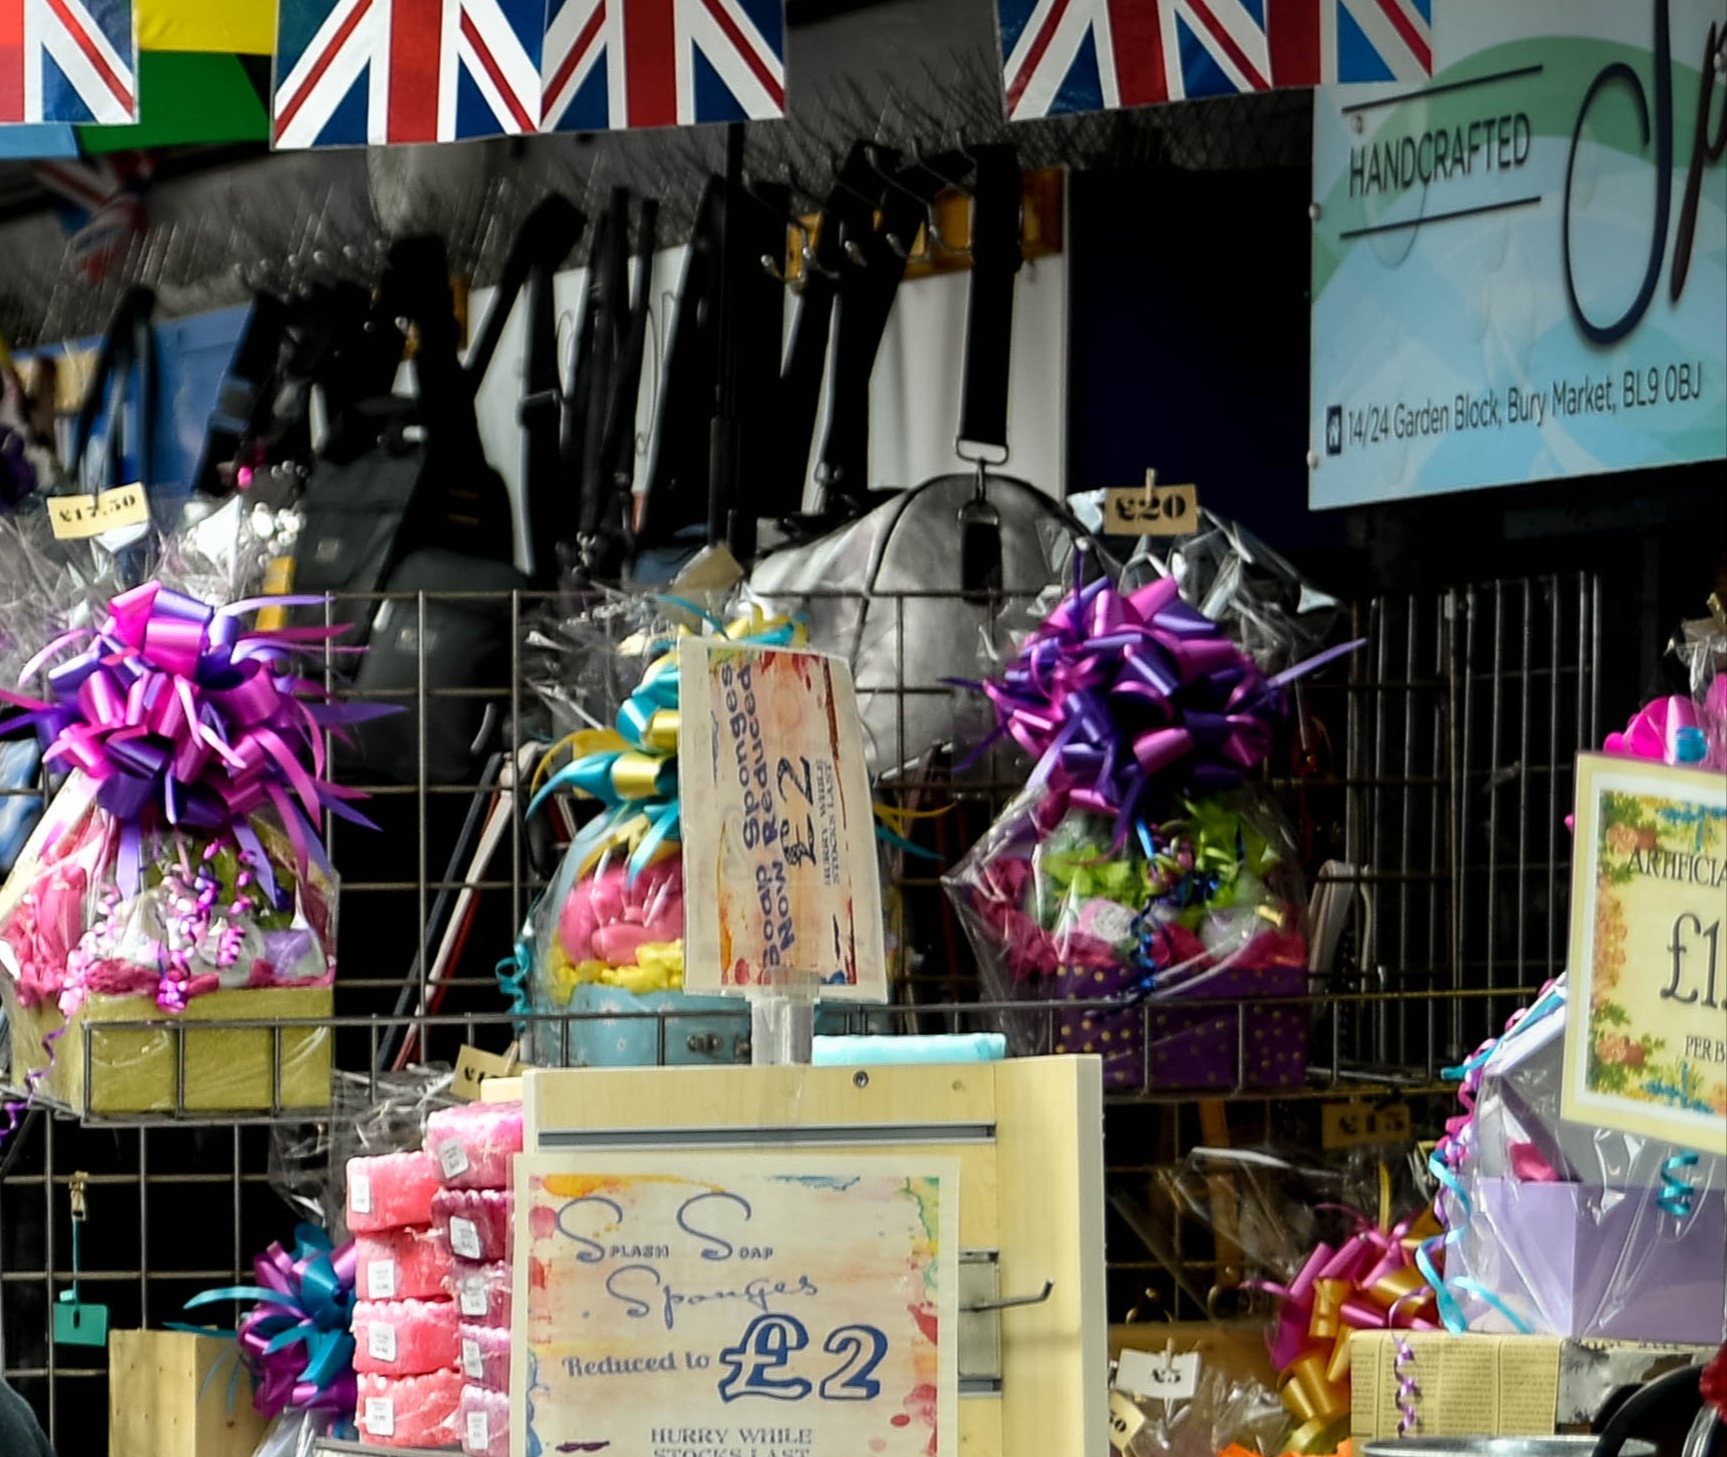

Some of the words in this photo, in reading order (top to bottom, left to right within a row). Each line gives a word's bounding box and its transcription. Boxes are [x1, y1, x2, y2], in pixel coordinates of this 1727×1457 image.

[1349, 111, 1531, 198] HANDCRAFTED
[1347, 404, 1389, 447] 14/24
[1393, 402, 1449, 440] Garden
[1454, 389, 1502, 431] Block,
[1507, 386, 1547, 428] Bury
[1552, 375, 1616, 417] Market,
[1623, 367, 1658, 409] BL9
[1115, 494, 1187, 521] £20
[721, 663, 761, 850] Sponges
[736, 664, 779, 847] Reduced
[755, 863, 781, 970] Soap
[771, 861, 796, 952] Now
[556, 1195, 670, 1263] SPLASH
[676, 1190, 774, 1261] SOAP
[605, 1263, 818, 1330] Sponges
[562, 1352, 677, 1378] Reduced
[685, 1351, 711, 1370] to
[717, 1312, 889, 1404] £2
[651, 1427, 729, 1445] HURRY
[737, 1427, 813, 1445] WHILE
